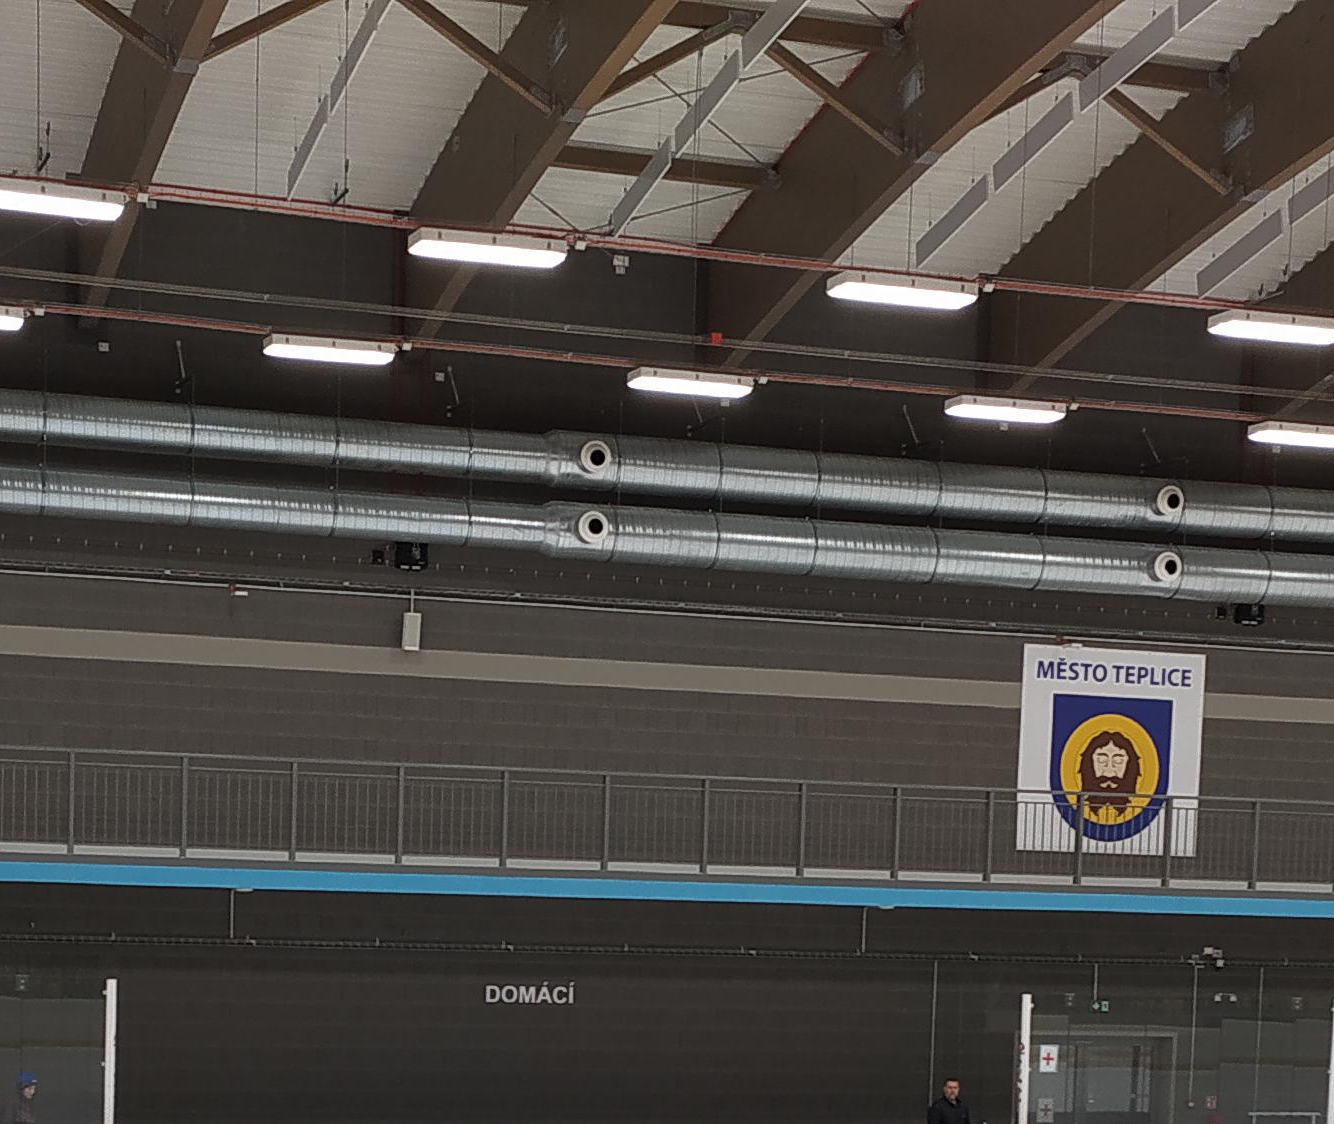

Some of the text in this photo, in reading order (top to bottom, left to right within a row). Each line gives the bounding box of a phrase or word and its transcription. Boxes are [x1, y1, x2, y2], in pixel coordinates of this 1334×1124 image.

[1036, 658, 1192, 687] MĚSTO TEPLICE
[485, 981, 575, 1004] DOMÁCÍ
